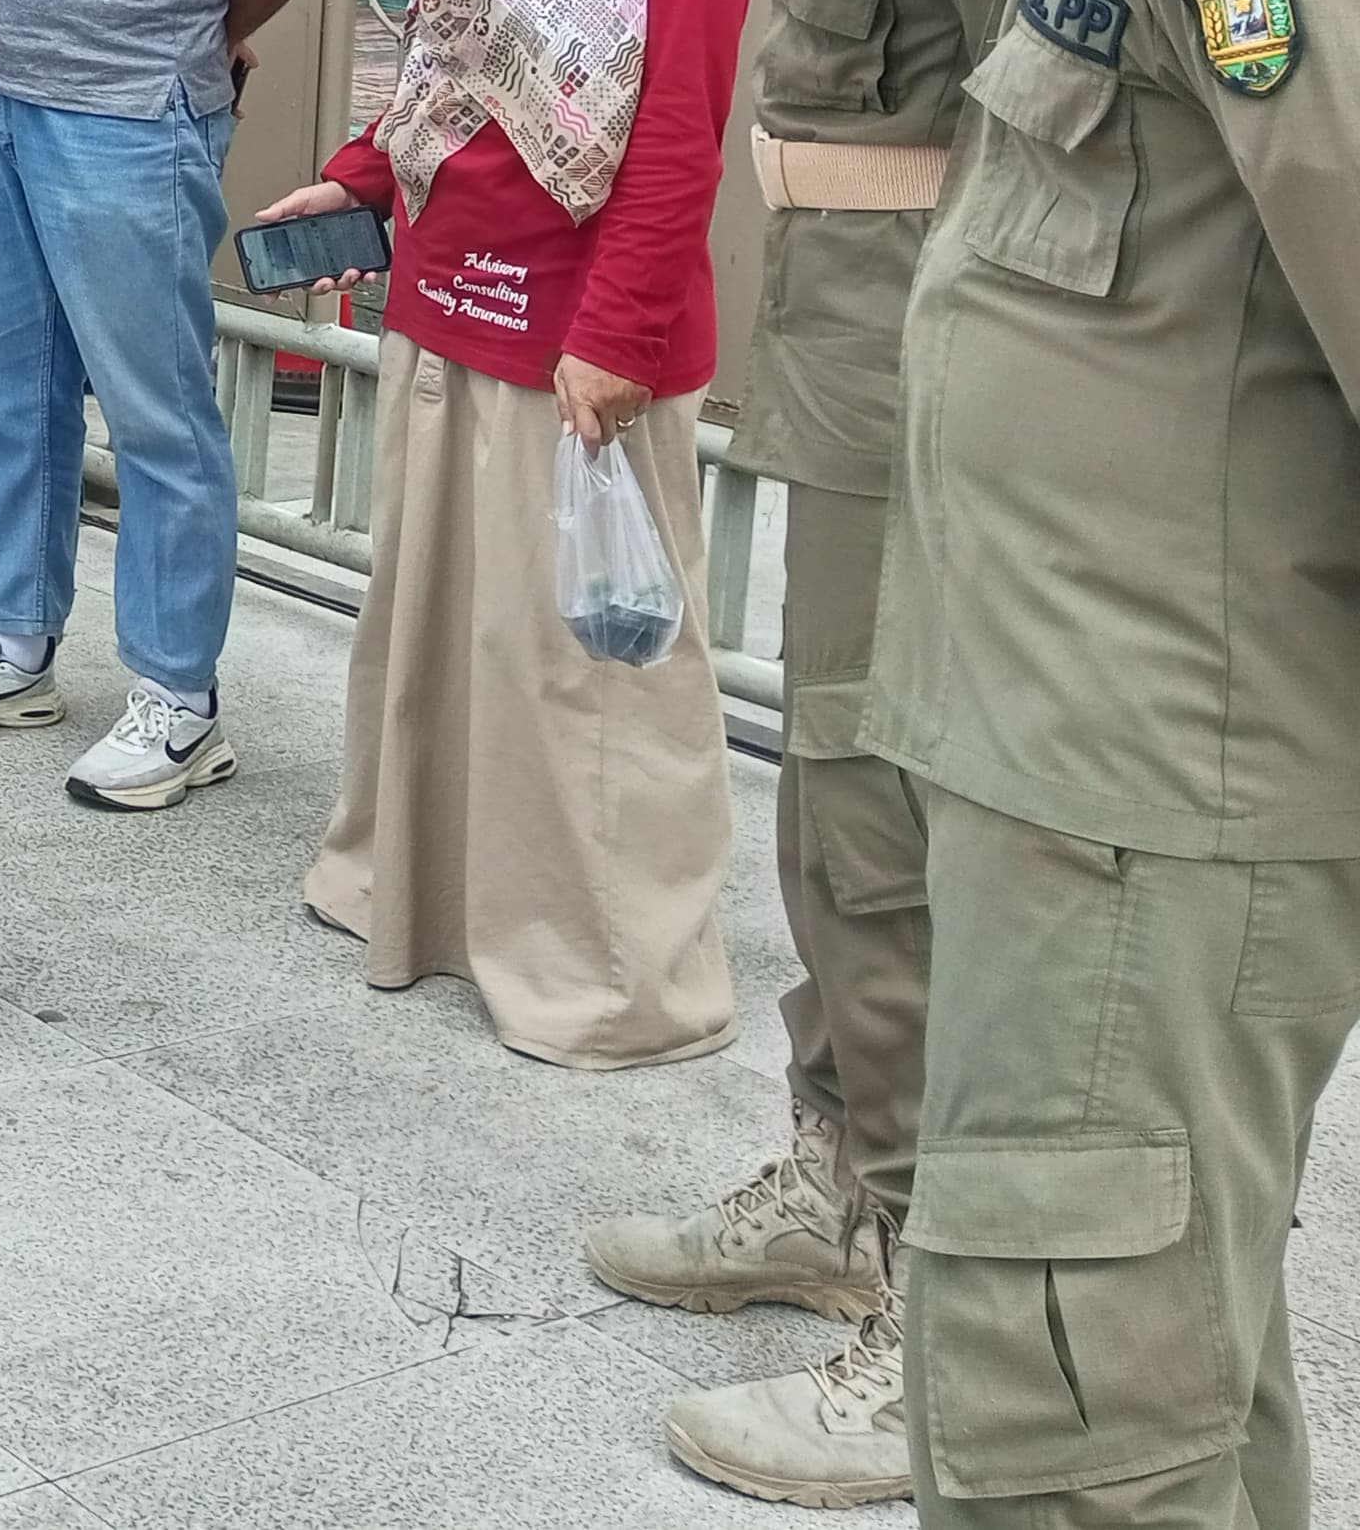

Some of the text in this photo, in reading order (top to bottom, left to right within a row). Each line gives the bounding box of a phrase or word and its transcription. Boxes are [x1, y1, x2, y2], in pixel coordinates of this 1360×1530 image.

[463, 252, 529, 284] Advisory
[452, 274, 529, 314] Consulting
[457, 298, 529, 331] Assurance
